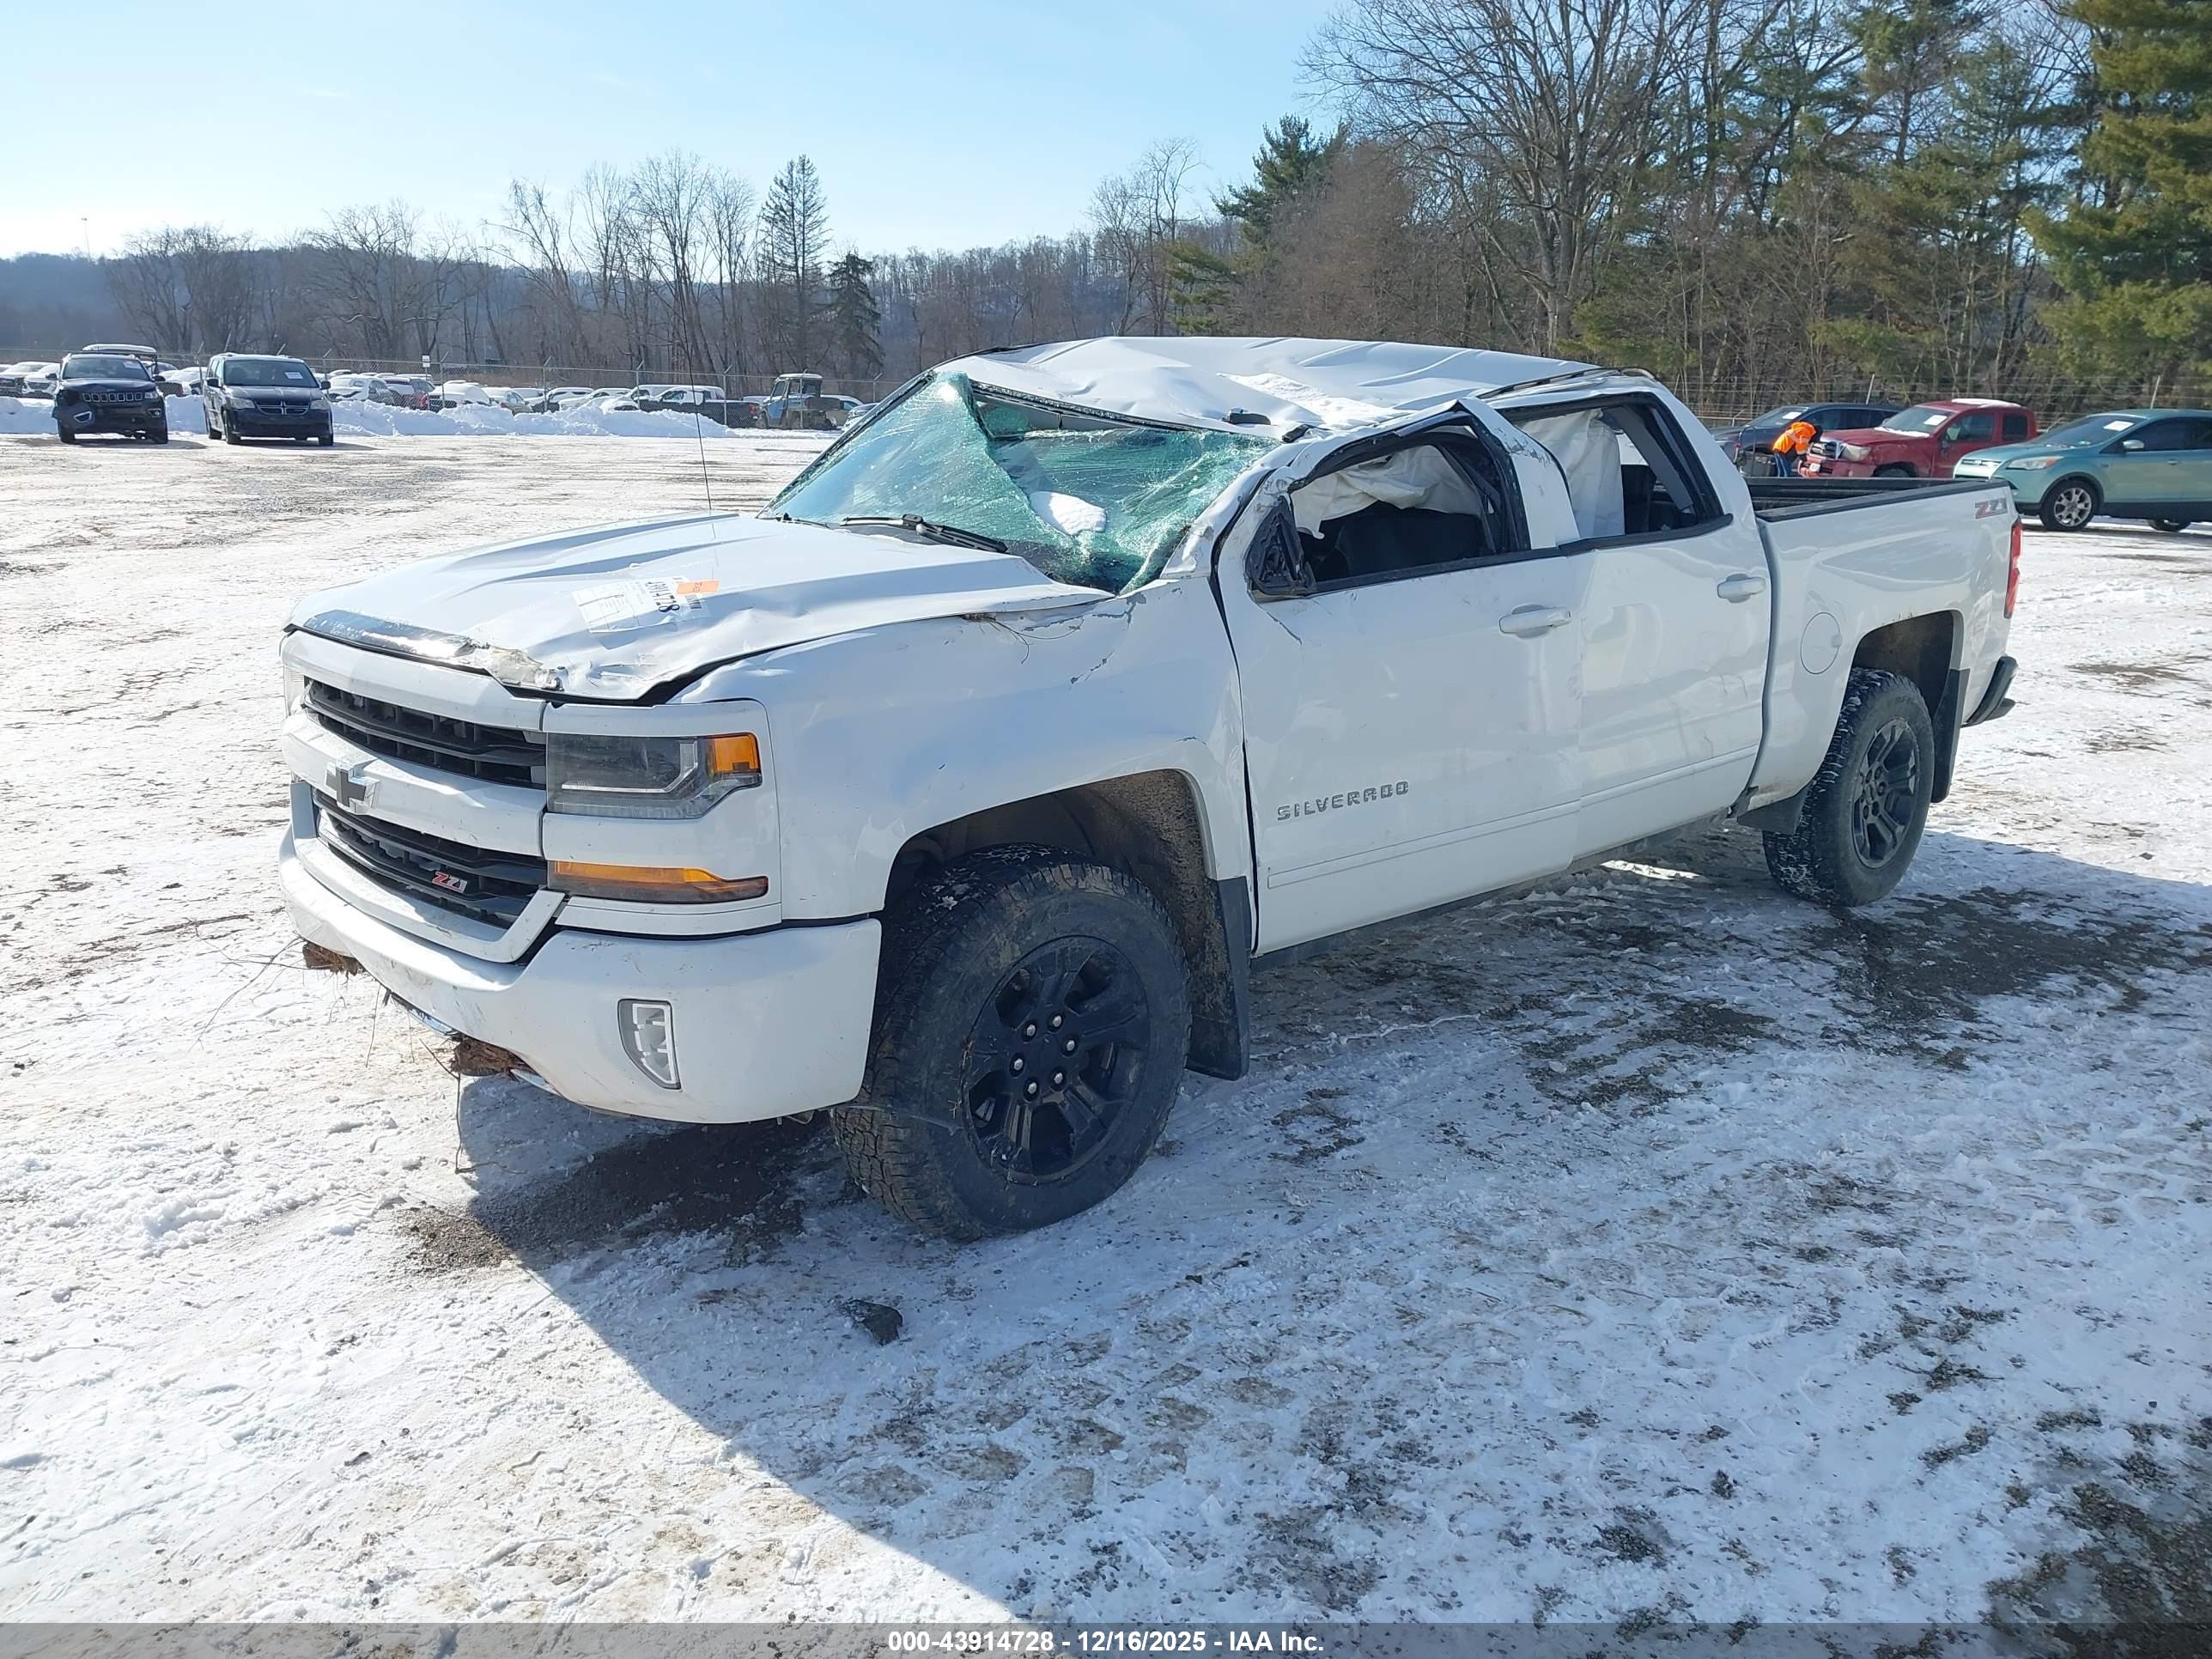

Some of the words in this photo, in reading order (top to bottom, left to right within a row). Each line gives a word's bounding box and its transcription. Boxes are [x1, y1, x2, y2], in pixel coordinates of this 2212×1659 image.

[1974, 498, 2008, 520] Z71
[1277, 781, 1409, 821] SILVERADO
[432, 871, 468, 894] Z71
